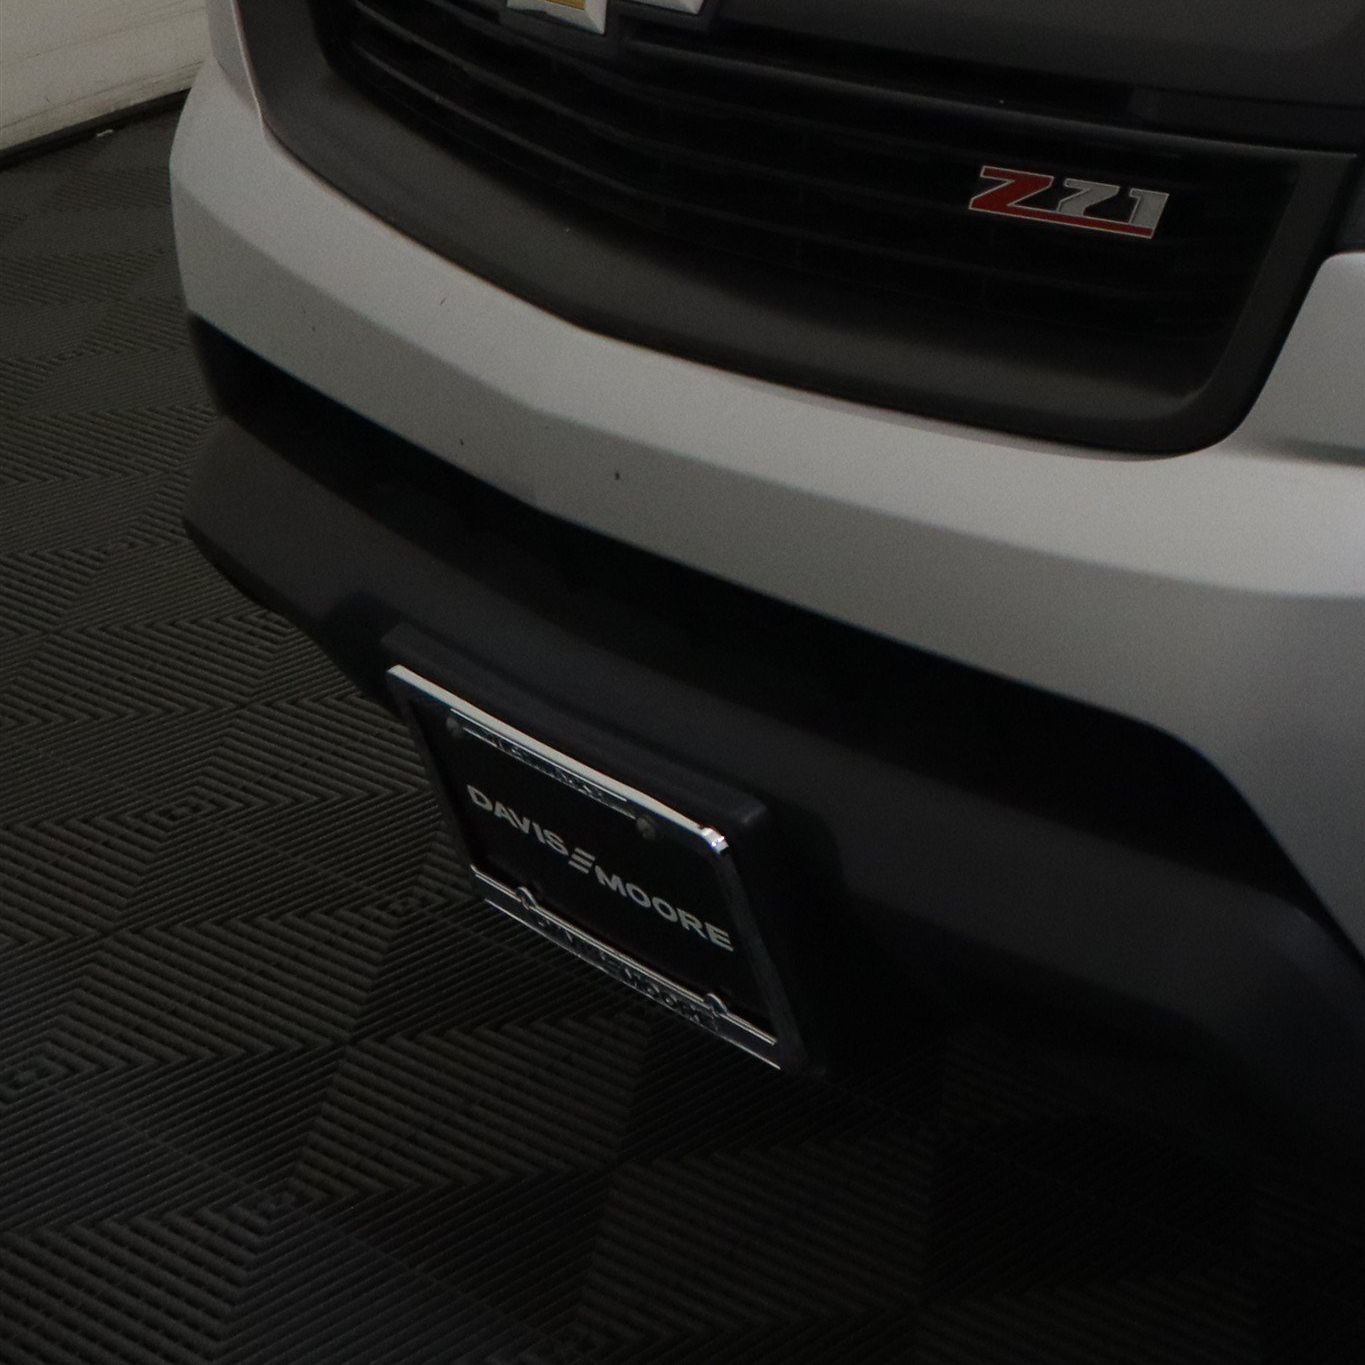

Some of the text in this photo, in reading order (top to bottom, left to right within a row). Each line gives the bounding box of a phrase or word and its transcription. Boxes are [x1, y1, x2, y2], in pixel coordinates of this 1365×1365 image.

[968, 165, 1170, 239] Z71
[466, 784, 735, 952] DAVIS MOORE
